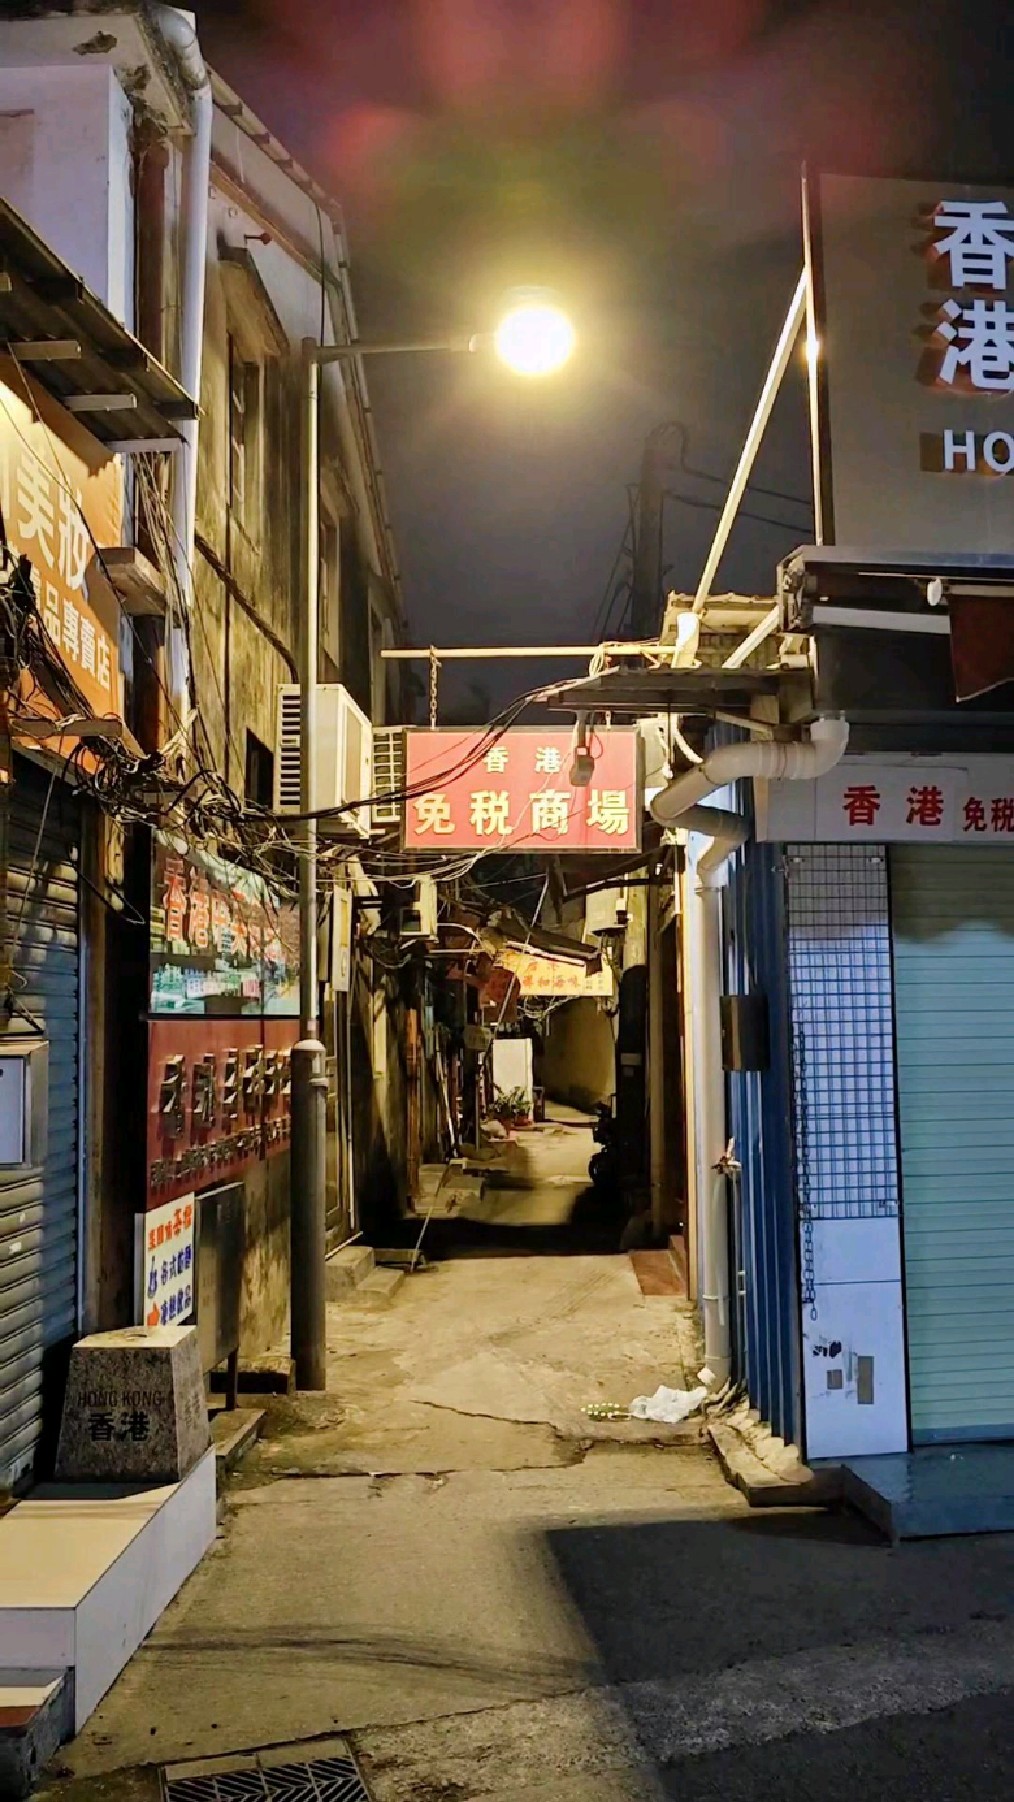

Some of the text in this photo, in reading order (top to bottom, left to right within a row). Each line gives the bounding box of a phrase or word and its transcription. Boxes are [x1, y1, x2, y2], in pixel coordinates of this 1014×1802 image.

[483, 745, 562, 774] 香港
[843, 785, 944, 827] 香港
[78, 1391, 162, 1408] HONG KONG
[88, 1411, 151, 1442] 香港
